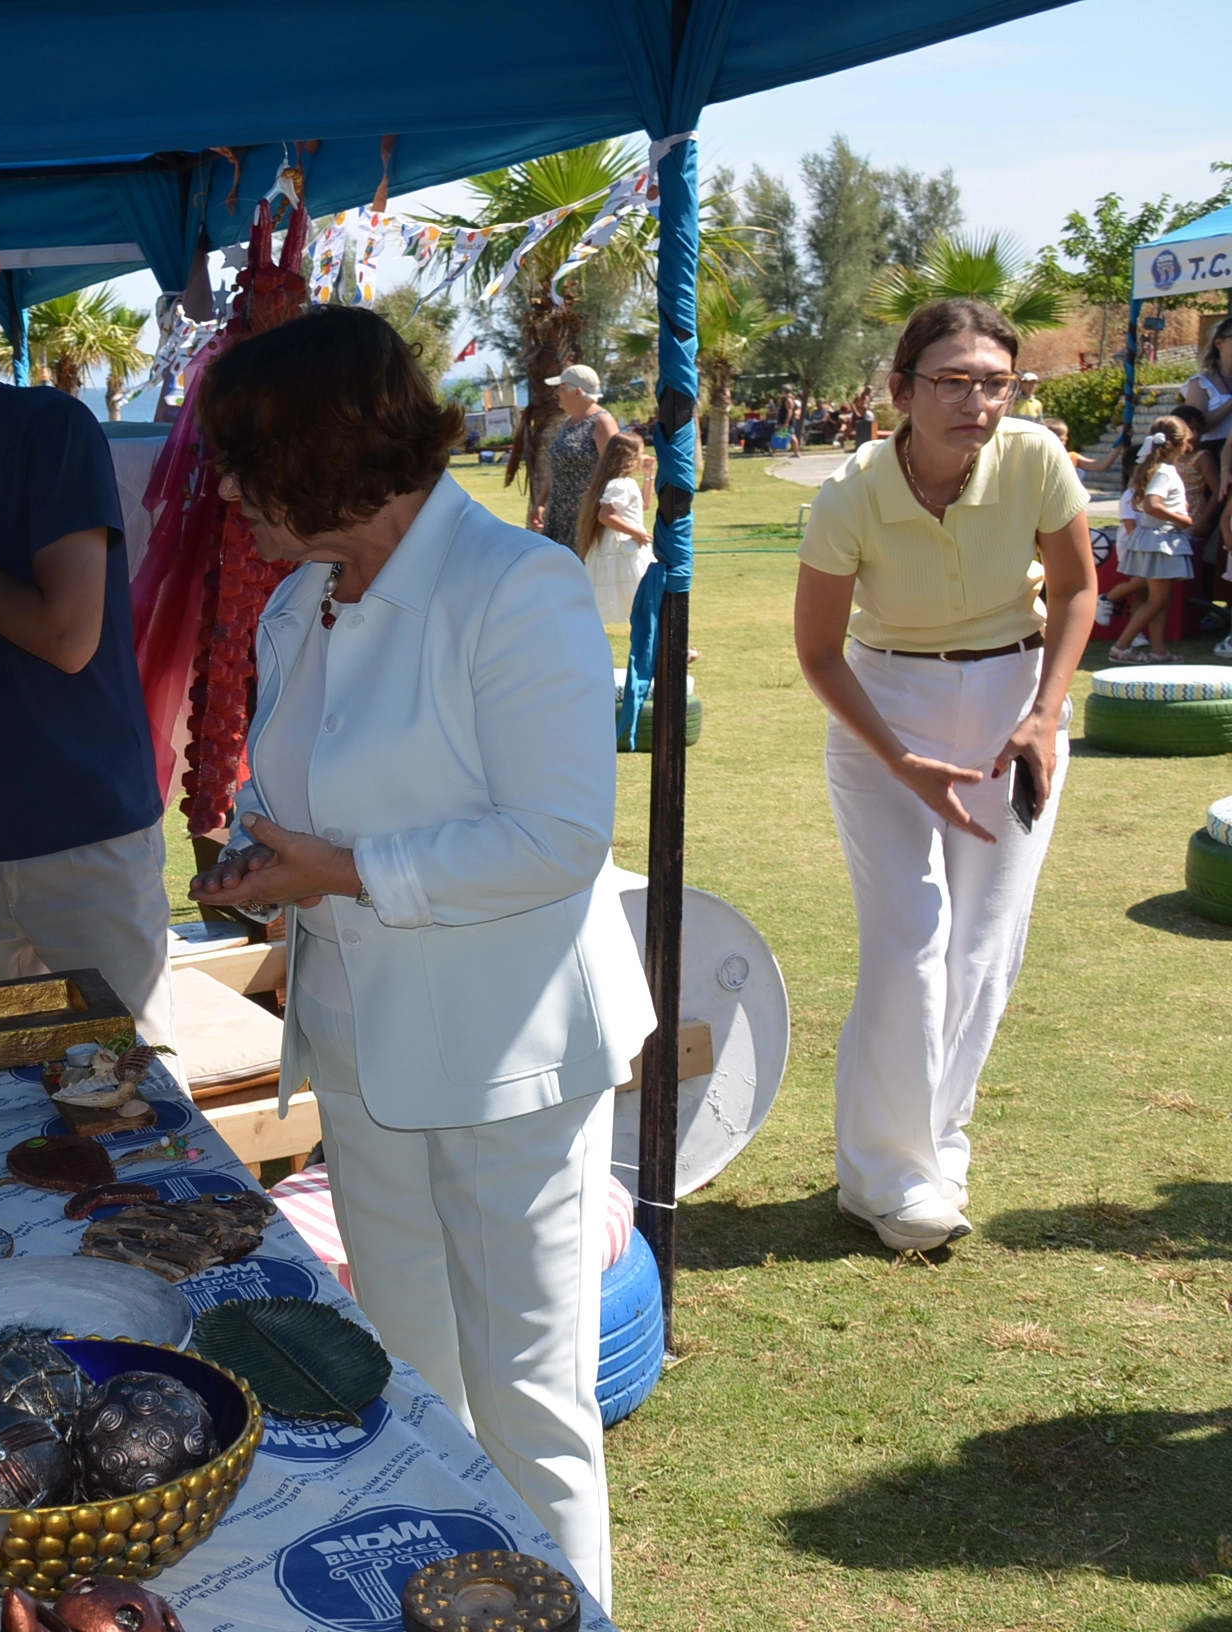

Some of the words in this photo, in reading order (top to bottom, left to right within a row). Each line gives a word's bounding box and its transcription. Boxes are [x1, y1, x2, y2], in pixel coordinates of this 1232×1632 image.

[1188, 253, 1231, 281] T.C.
[329, 1494, 363, 1523] DESTEK
[310, 1520, 442, 1555] DİDİM
